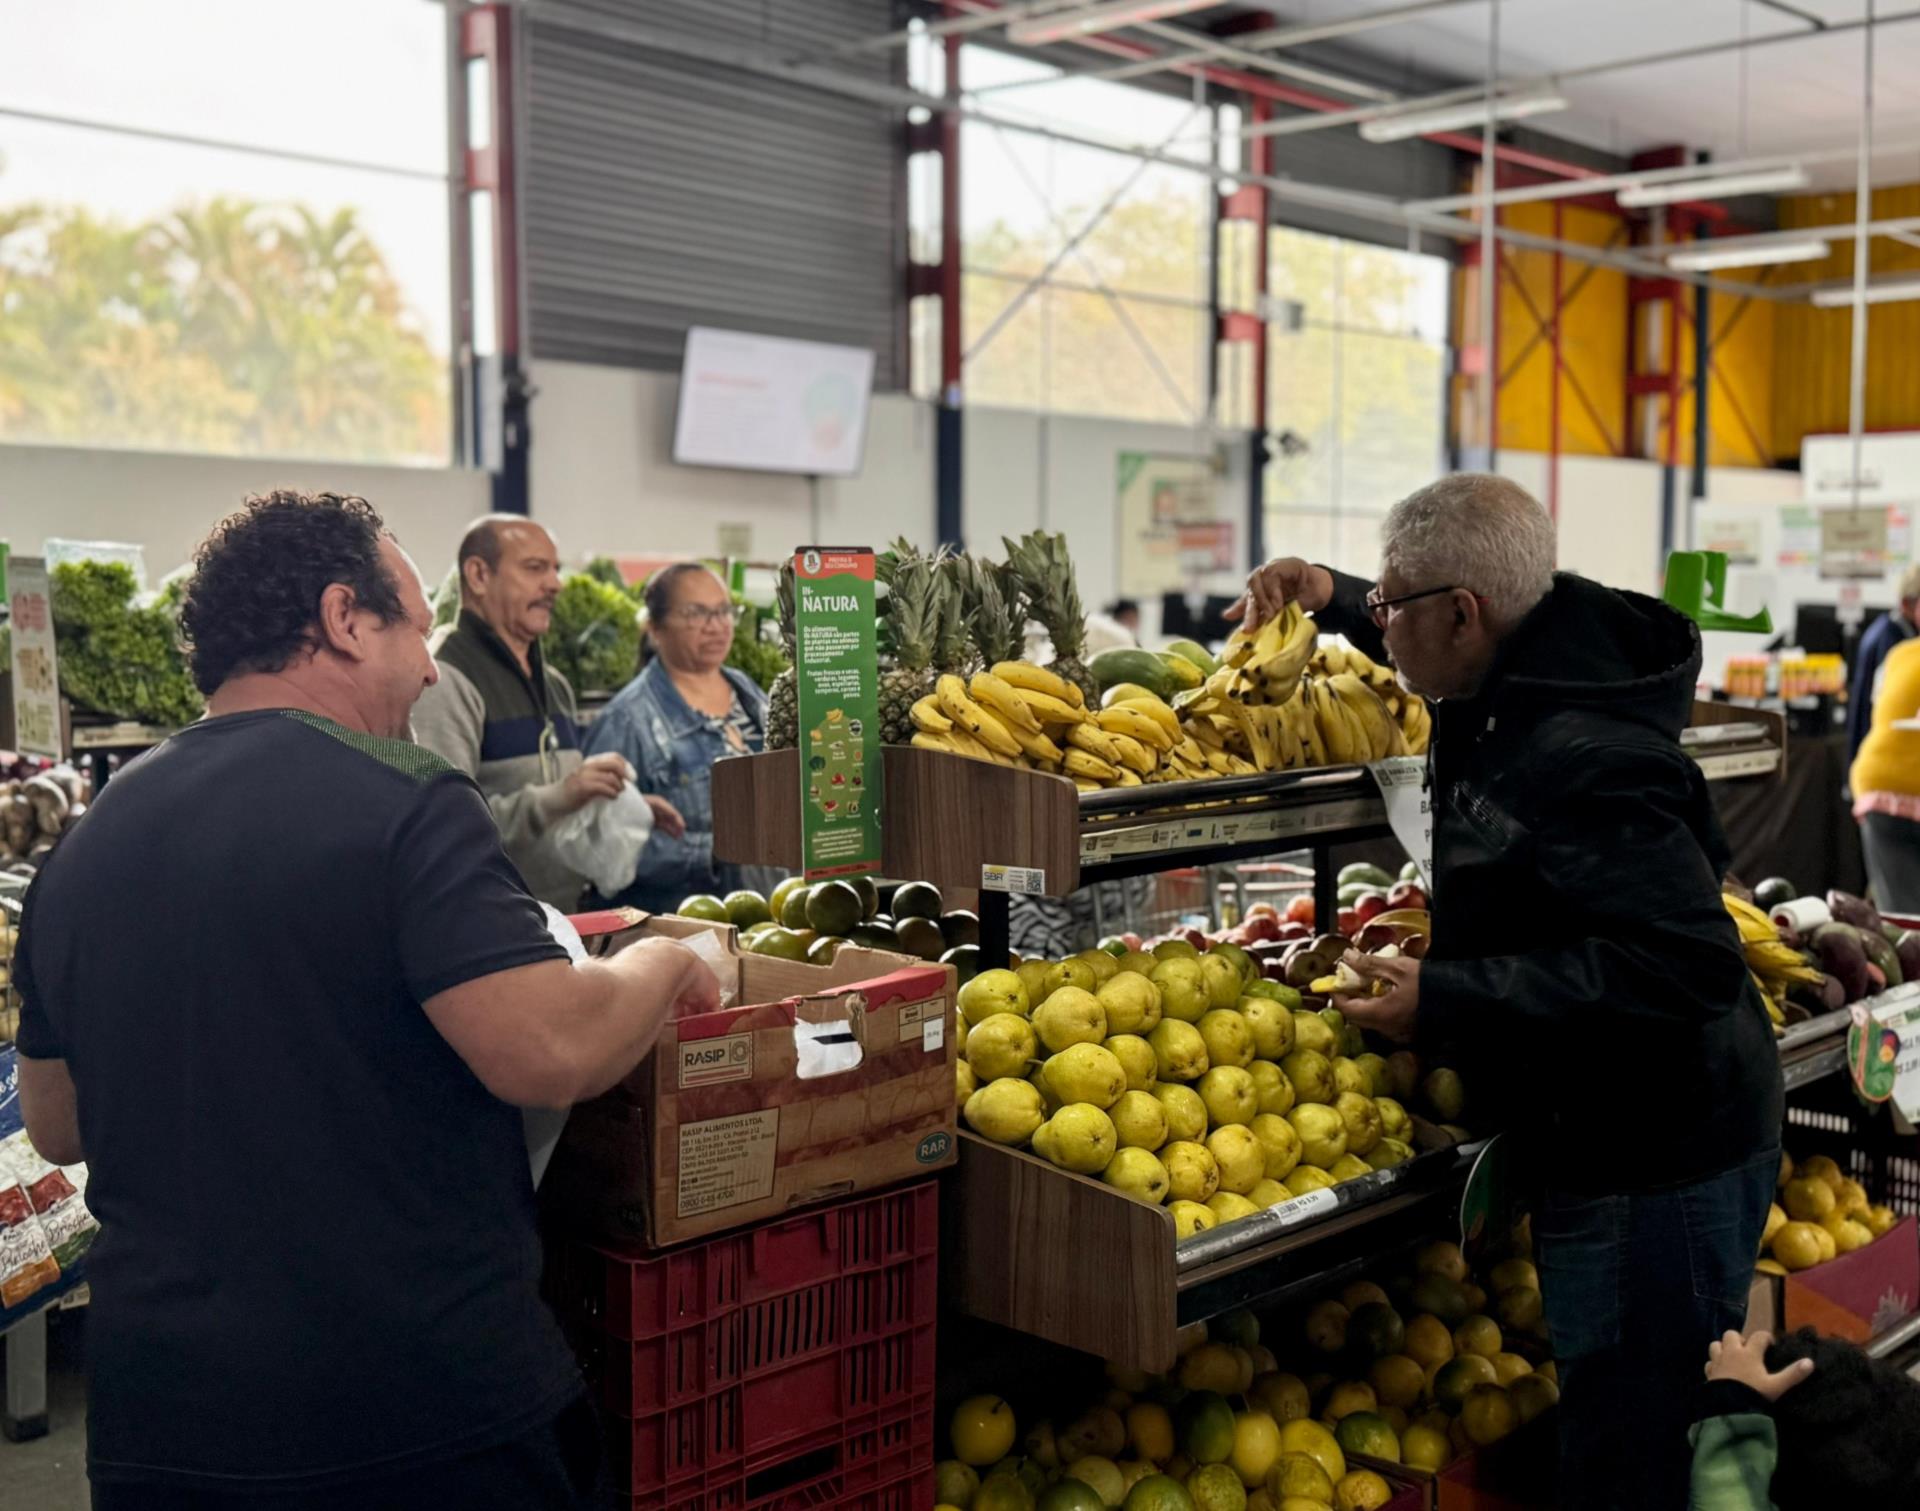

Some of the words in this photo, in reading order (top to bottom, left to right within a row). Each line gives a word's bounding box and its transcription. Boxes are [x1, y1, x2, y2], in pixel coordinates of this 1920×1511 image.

[803, 596, 859, 613] NATURA
[684, 1048, 726, 1067] RASIP
[682, 1127, 703, 1137] RASIP
[704, 1120, 743, 1133] ALIMENTOS
[921, 1138, 946, 1157] RAR
